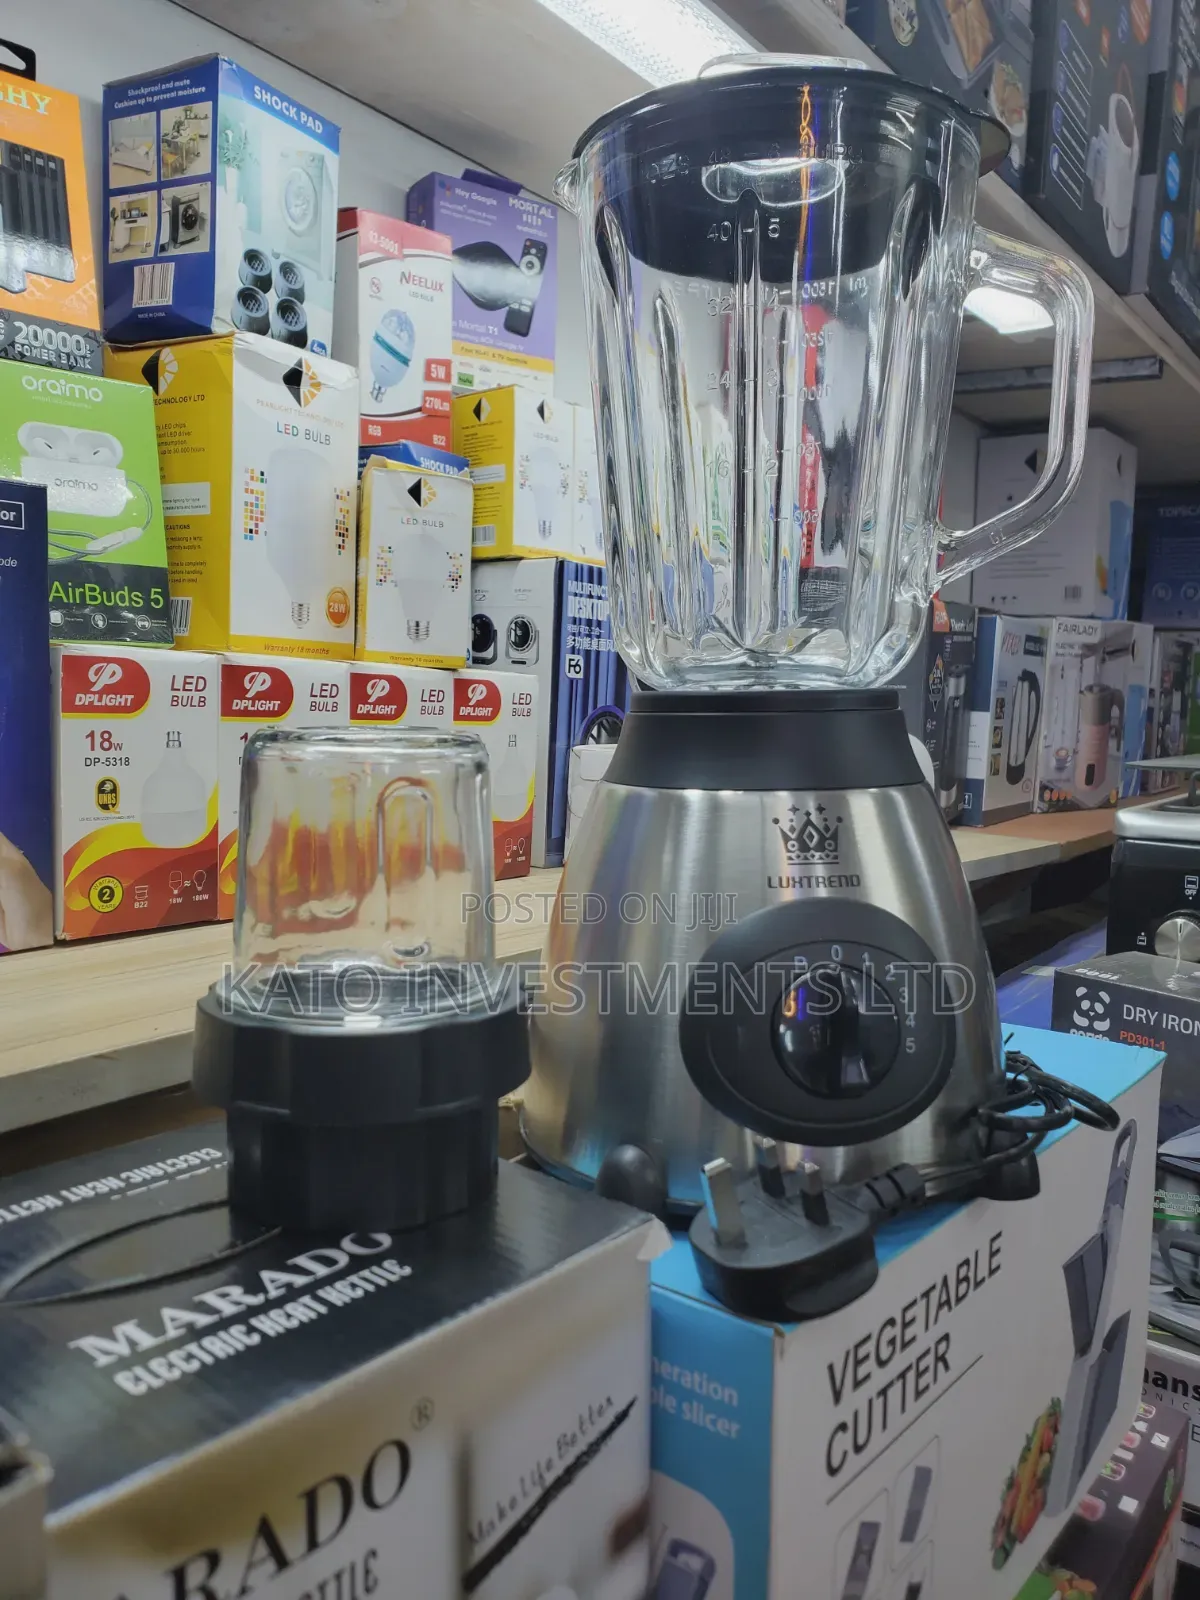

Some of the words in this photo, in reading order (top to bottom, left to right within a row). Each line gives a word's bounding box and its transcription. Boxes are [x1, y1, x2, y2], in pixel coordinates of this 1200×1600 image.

[0, 83, 52, 115] HY
[254, 85, 298, 121] SHOCK
[300, 104, 323, 134] PAD
[508, 197, 556, 219] MORTAL
[706, 220, 732, 241] 40
[768, 217, 781, 238] 5
[400, 269, 445, 293] NEELUX
[13, 321, 87, 356] 20000
[14, 343, 57, 362] POWER
[60, 352, 92, 370] BANK
[430, 363, 447, 380] 5W
[22, 375, 104, 402] oraimo
[194, 394, 206, 402] LTD
[276, 421, 299, 437] LED
[304, 428, 331, 446] BULB
[368, 424, 382, 437] RGB
[420, 456, 446, 474] SHOCK
[446, 464, 459, 477] PAD
[54, 478, 98, 491] oraimo
[401, 517, 418, 526] LED
[422, 519, 444, 528] BULB
[49, 580, 145, 608] AirBuds
[150, 588, 164, 609] 5
[329, 602, 345, 614] 28W
[567, 595, 610, 621] DESKTOP
[1057, 622, 1099, 637] FAIRLADY
[263, 643, 295, 654] Warranty
[305, 646, 330, 655] months
[567, 657, 582, 675] F6
[170, 674, 207, 693] LED
[309, 682, 339, 699] LED
[74, 693, 134, 706] DPLIGHT
[170, 695, 207, 708] BULB
[420, 688, 445, 704] LED
[512, 692, 533, 706] LED
[231, 699, 281, 711] DPLIGHT
[309, 700, 339, 713] BULB
[356, 703, 397, 715] DPLIGHT
[420, 703, 445, 716] BULB
[459, 705, 494, 718] DPLIGHT
[511, 707, 532, 718] BULB
[84, 756, 131, 768] DP-5318
[98, 793, 117, 805] UNBS
[766, 874, 861, 889] LUXTREND
[102, 888, 111, 900] 2
[1184, 888, 1197, 896] OFF
[134, 901, 148, 909] B22
[830, 945, 843, 961] 0
[861, 952, 871, 966] 1
[884, 964, 898, 981] 2
[899, 987, 909, 1003] 3
[905, 1012, 916, 1028] 4
[1123, 1004, 1159, 1026] DRY
[904, 1037, 916, 1053] 5
[1120, 1030, 1167, 1051] PD301-1
[69, 1232, 393, 1369] MARADO
[827, 1230, 1005, 1408] VEGETABLE
[113, 1323, 262, 1397] ELECTRIC
[249, 1295, 329, 1339] HEAT
[825, 1331, 952, 1478] CUTTER
[682, 1399, 741, 1439] slicer
[556, 1396, 614, 1461] Better
[110, 1439, 411, 1600] RADO
